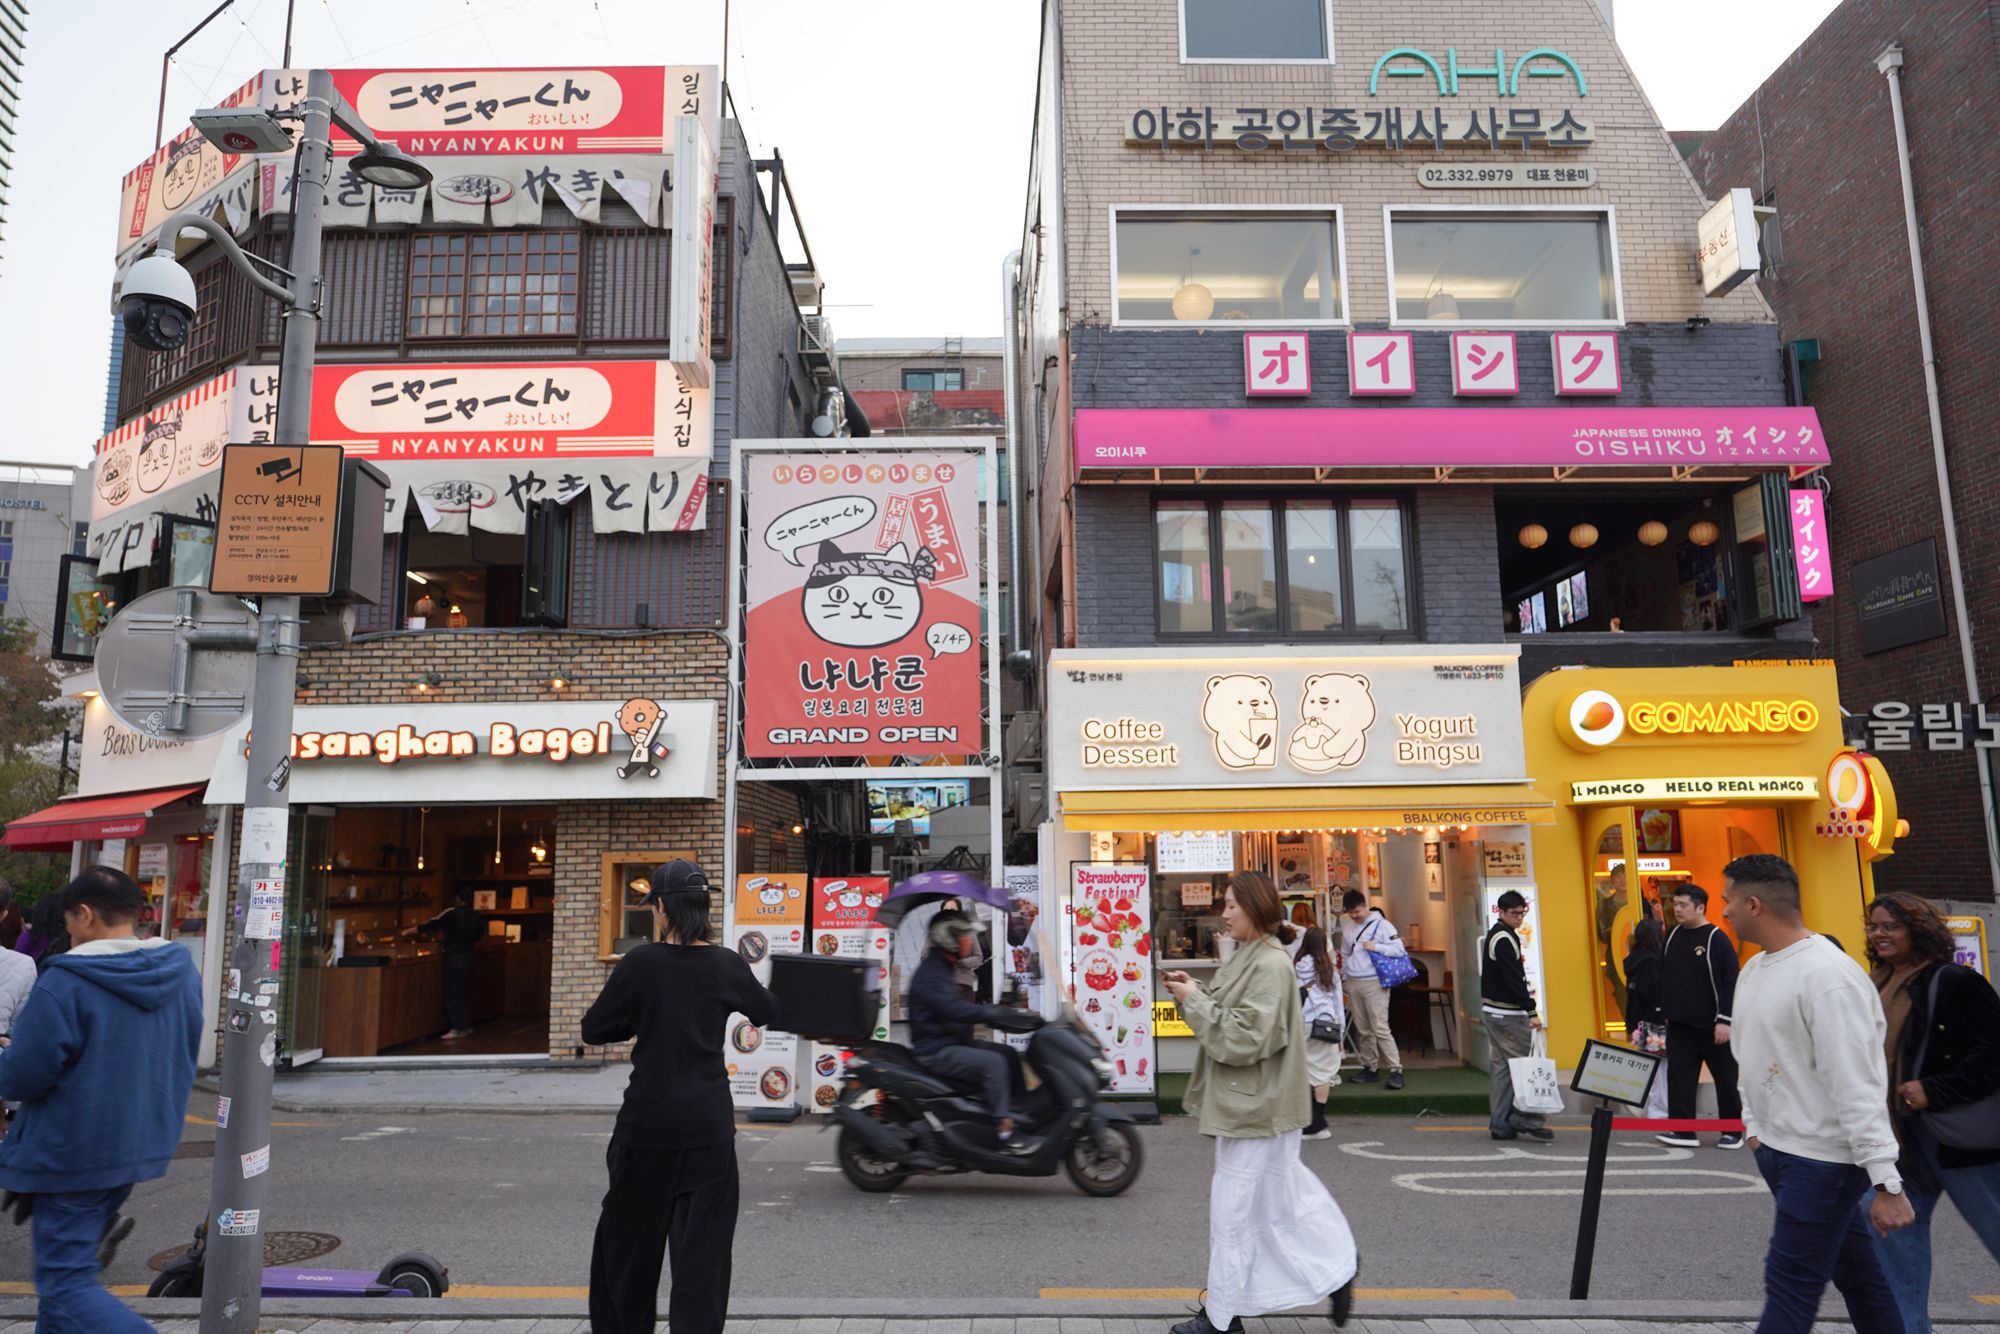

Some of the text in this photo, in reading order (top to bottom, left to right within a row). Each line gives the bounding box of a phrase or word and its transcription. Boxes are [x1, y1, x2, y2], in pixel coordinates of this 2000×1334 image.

[1369, 46, 1588, 97] AHA
[527, 112, 590, 126] おいしい!
[1132, 106, 1593, 152] 아하 공인중개사 사무소
[410, 136, 566, 152] NYANYAKUN
[1425, 168, 1514, 182] 02.332.9979
[1526, 168, 1590, 182] 대표 천윤미
[1697, 227, 1731, 263] 부동산
[1258, 340, 1605, 385] オイシク
[504, 411, 571, 426] おいしい!
[1572, 428, 1703, 438] JAPANESE DINING
[1715, 425, 1815, 446] オイシク
[391, 437, 546, 454] NYANYAKUN
[1094, 446, 1148, 458] 오이시쿠
[1574, 440, 1707, 457] OISHIKU
[1716, 447, 1820, 456] IZAKAYA
[774, 466, 955, 484] いらっしゃいませ
[234, 494, 322, 507] CCTV 설치안내
[1794, 494, 1822, 590] オイシク
[932, 633, 967, 645] 2/4F
[799, 656, 927, 692] 냐냐쿤
[802, 697, 924, 717] 일본요리 전문점
[1627, 700, 1820, 734] GOMANGO
[767, 726, 959, 745] GRAND OPEN
[1083, 718, 1163, 740] Coffee
[1396, 715, 1477, 740] Yogurt
[488, 721, 612, 763] Bagel
[1083, 744, 1178, 766] Dessert
[1398, 740, 1481, 767] Bingsu
[1586, 782, 1645, 796] MANGO
[1666, 781, 1713, 793] HELLO
[1717, 780, 1756, 793] REAL
[1758, 780, 1805, 792] MANGO
[1402, 810, 1528, 825] BBALKONG COFFEE
[1077, 869, 1148, 888] Strawberry
